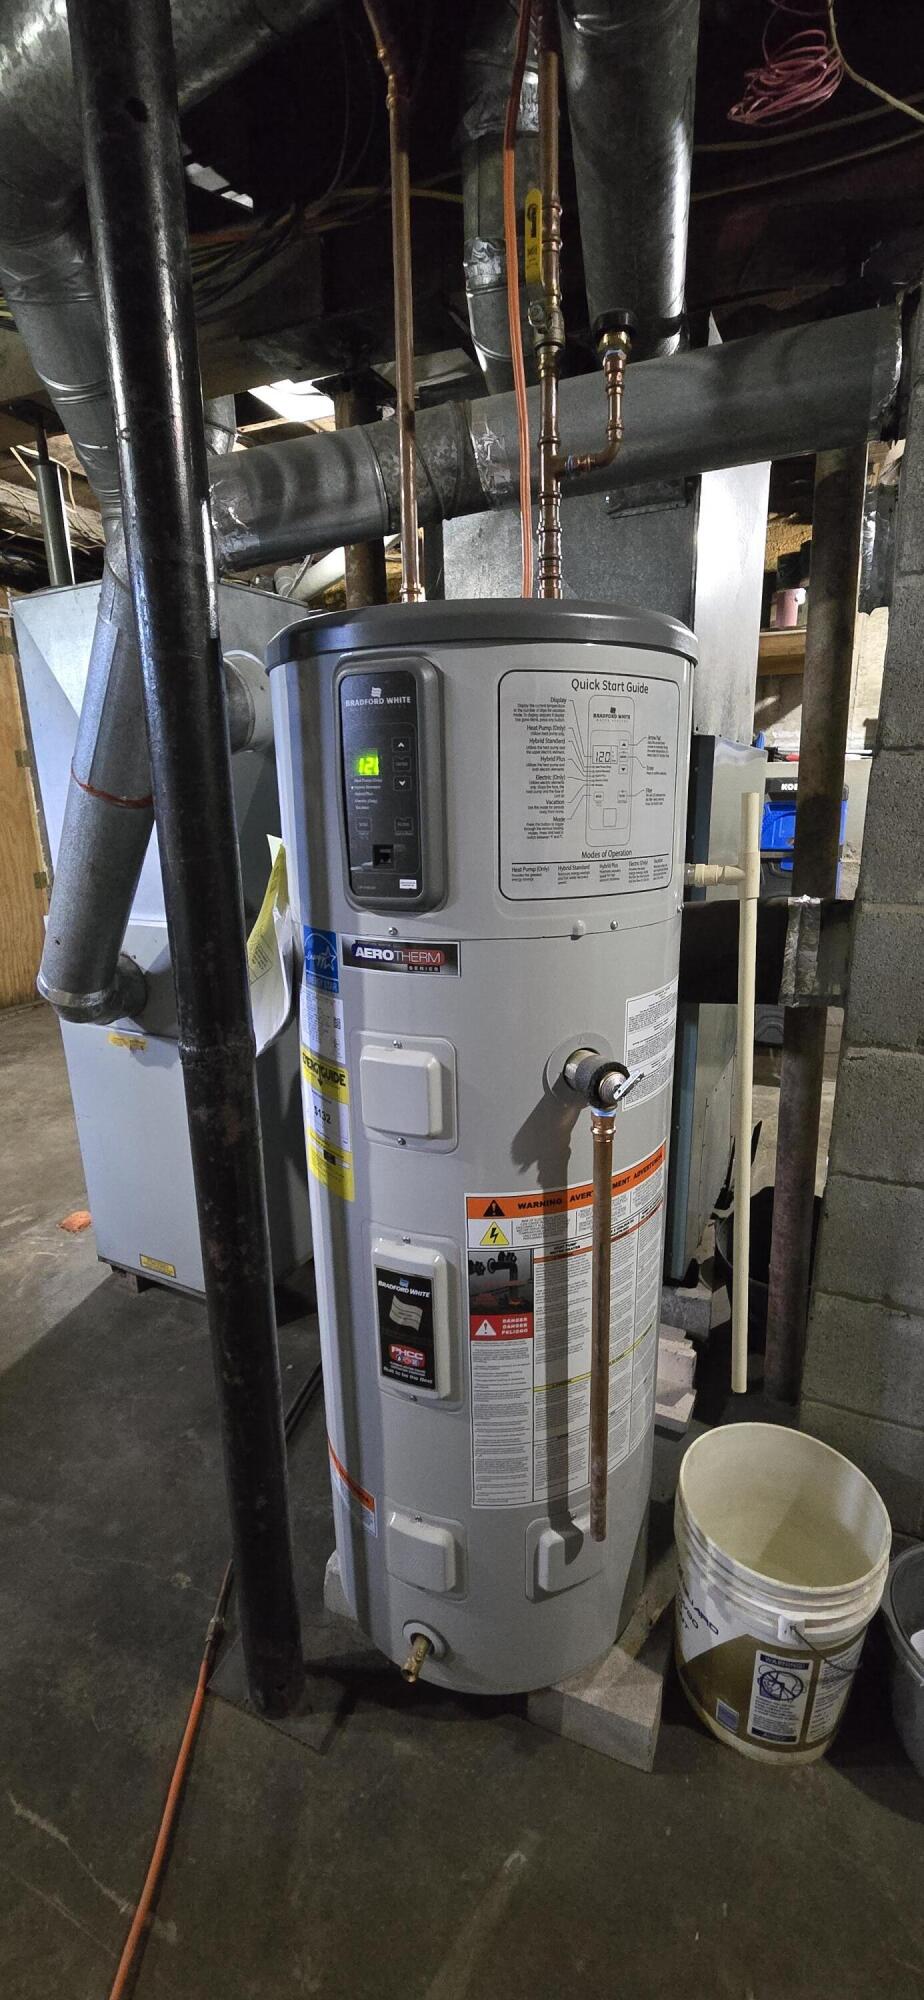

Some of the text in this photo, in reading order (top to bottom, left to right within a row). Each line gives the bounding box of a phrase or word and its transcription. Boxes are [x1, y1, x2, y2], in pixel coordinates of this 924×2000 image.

[571, 678, 649, 694] Quick Start Guide
[345, 696, 411, 707] BRADFORD WHITE
[595, 751, 611, 762] 120
[581, 849, 633, 859] Modes of Operation
[355, 946, 441, 963] AEROTHERM
[517, 1198, 563, 1210] WARNING
[377, 1280, 431, 1298] BRADFORD WHITE
[391, 1345, 424, 1360] PHCC
